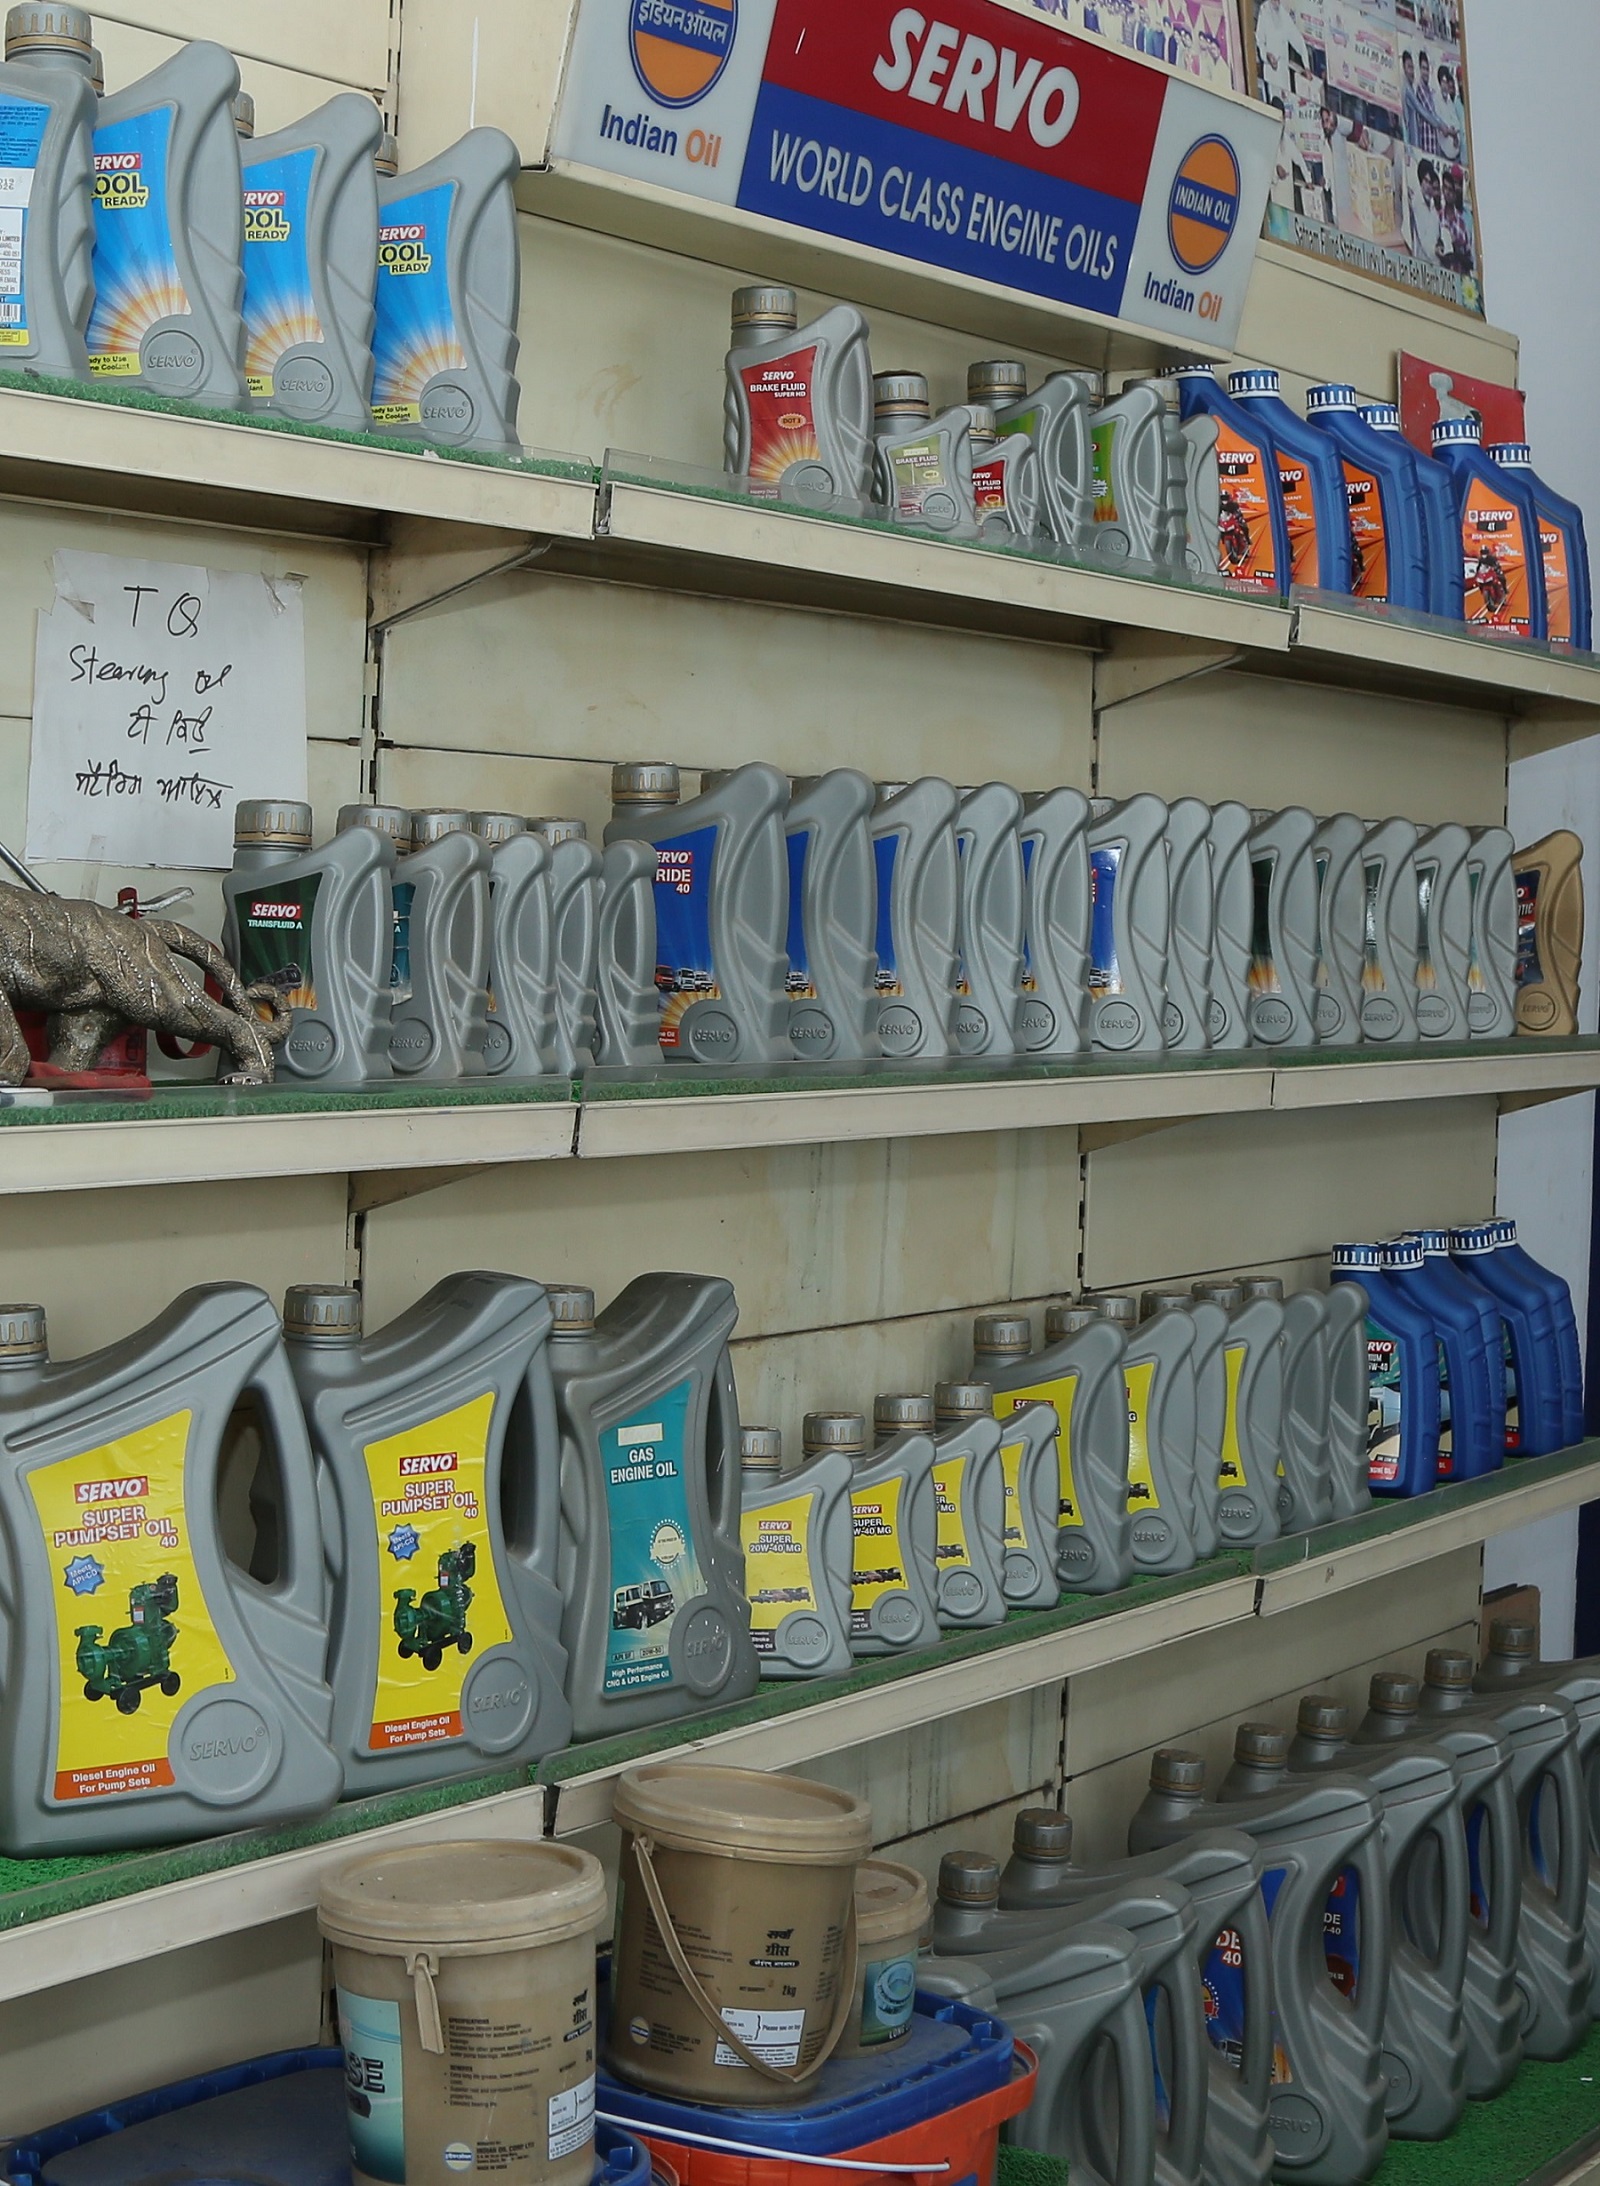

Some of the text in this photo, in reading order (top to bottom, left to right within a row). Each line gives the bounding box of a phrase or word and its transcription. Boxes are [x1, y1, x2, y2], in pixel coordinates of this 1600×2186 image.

[872, 7, 1080, 148] SERVO
[600, 104, 722, 168] Indian Oil
[94, 154, 136, 169] ERVO
[93, 175, 146, 195] OOL
[105, 196, 146, 206] READY
[770, 129, 1118, 281] WORLD CLASS ENGINE OILS
[1175, 184, 1231, 225] INDIAN OIL
[248, 230, 287, 239] READY
[392, 263, 429, 273] READY
[1144, 271, 1223, 322] Indian Oil
[149, 356, 195, 368] SERVO
[762, 371, 795, 381] SERVO
[280, 380, 327, 392] SERVO
[750, 383, 806, 392] BRAKE FLUID
[423, 407, 467, 419] SERVO
[896, 454, 938, 465] BRAKE FLUID
[1219, 452, 1255, 463] SERVO
[1228, 465, 1236, 474] 4T
[1279, 470, 1302, 481] RVO
[1346, 482, 1371, 493] RVO
[1479, 511, 1513, 520] SERVO
[1487, 522, 1496, 530] 4T
[123, 585, 201, 638] T Q
[657, 851, 690, 864] ERVO
[656, 868, 691, 883] RIDE
[676, 883, 690, 894] 40
[253, 904, 297, 918] SERVO
[247, 919, 303, 929] TRANSFLUID A
[1101, 1018, 1134, 1028] SERVO
[1256, 1013, 1287, 1024] SERVO
[790, 1027, 827, 1039] SERVO
[878, 1023, 915, 1035] SERVO
[957, 1023, 980, 1033] RVO
[694, 1029, 733, 1042] SERVO
[290, 1040, 327, 1050] SERVO
[1367, 1341, 1392, 1352] RVO
[1128, 1413, 1136, 1421] G
[629, 1447, 654, 1463] GAS
[401, 1453, 453, 1475] SERVO
[611, 1462, 677, 1484] ENGINE OIL
[77, 1477, 144, 1502] SERVO
[405, 1479, 455, 1498] SUPER
[1006, 1488, 1013, 1496] G
[382, 1492, 478, 1517] PUMPSET OIL
[853, 1506, 880, 1514] SERVO
[941, 1503, 955, 1512] MG
[82, 1505, 146, 1527] SUPER
[464, 1507, 478, 1519] 40
[759, 1521, 789, 1530] SERVO
[853, 1526, 891, 1535] W-40 MG
[54, 1518, 177, 1548] PUMPSET OIL
[759, 1535, 792, 1543] SUPER
[1133, 1532, 1166, 1542] SERVO
[161, 1535, 178, 1548] 40
[750, 1543, 802, 1552] 20W-40 MG
[69, 1563, 92, 1578] Meets
[606, 1679, 620, 1688] CNG
[627, 1675, 640, 1684] LPG
[641, 1672, 660, 1682] Engine
[661, 1670, 670, 1678] Oil
[612, 1669, 626, 1678] High
[472, 1690, 520, 1713] SERVO
[384, 1716, 450, 1733] Diesel Engine Oil
[390, 1728, 446, 1744] For Pump Sets
[190, 1736, 258, 1761] SERVO
[72, 1763, 155, 1782] Diesel Engine Oil
[79, 1776, 151, 1794] For Pump Sets
[1216, 1930, 1240, 1949] DE
[1222, 1951, 1242, 1966] 40
